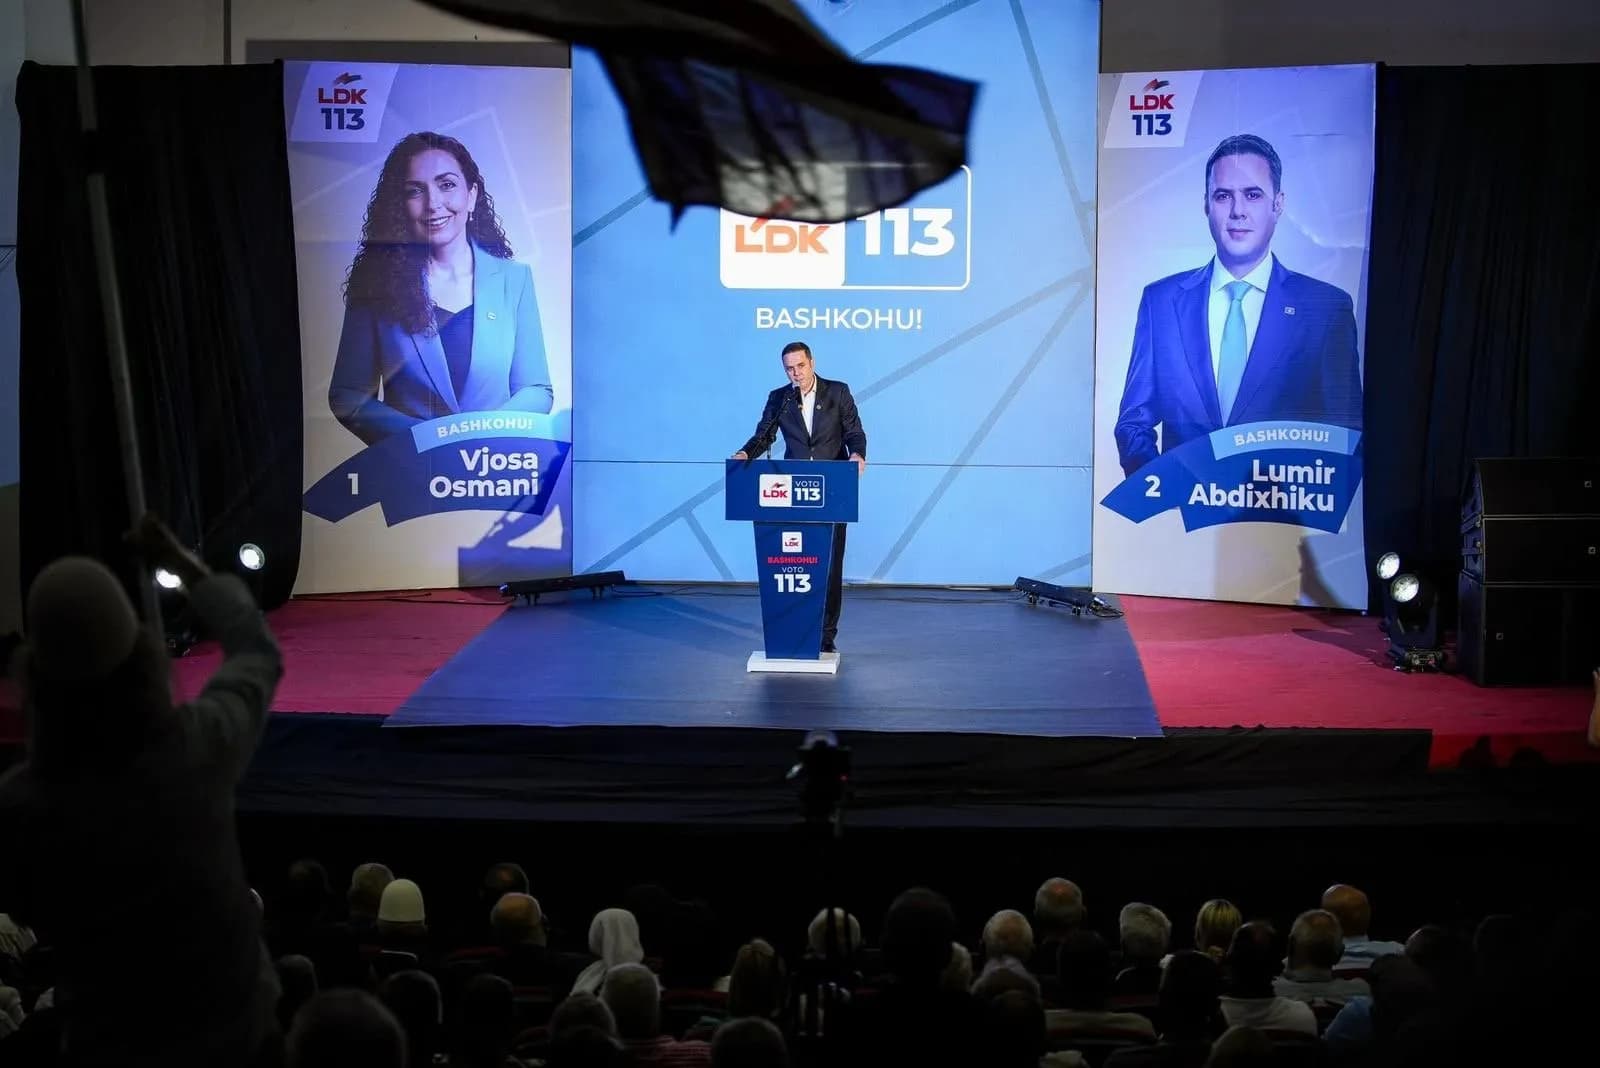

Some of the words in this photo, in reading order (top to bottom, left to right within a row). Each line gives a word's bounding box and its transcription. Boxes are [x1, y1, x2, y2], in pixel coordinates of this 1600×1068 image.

[318, 88, 367, 105] LDK
[1130, 94, 1175, 110] LDK
[321, 108, 365, 130] 113
[1132, 114, 1172, 135] 113
[735, 225, 830, 254] LDK
[856, 208, 955, 257] 113
[756, 307, 922, 330] BASHKOHU!
[437, 418, 533, 437] BASHKOHU!
[1234, 429, 1329, 446] BASHKOHU!
[460, 447, 538, 476] Vjosa
[1253, 459, 1336, 484] Lumir
[347, 473, 359, 495] 1
[429, 472, 538, 498] Osmani
[763, 490, 788, 498] LDK
[795, 488, 821, 501] 113
[1145, 475, 1161, 498] 2
[1188, 483, 1335, 512] Abdixhiku
[774, 574, 812, 593] 113
